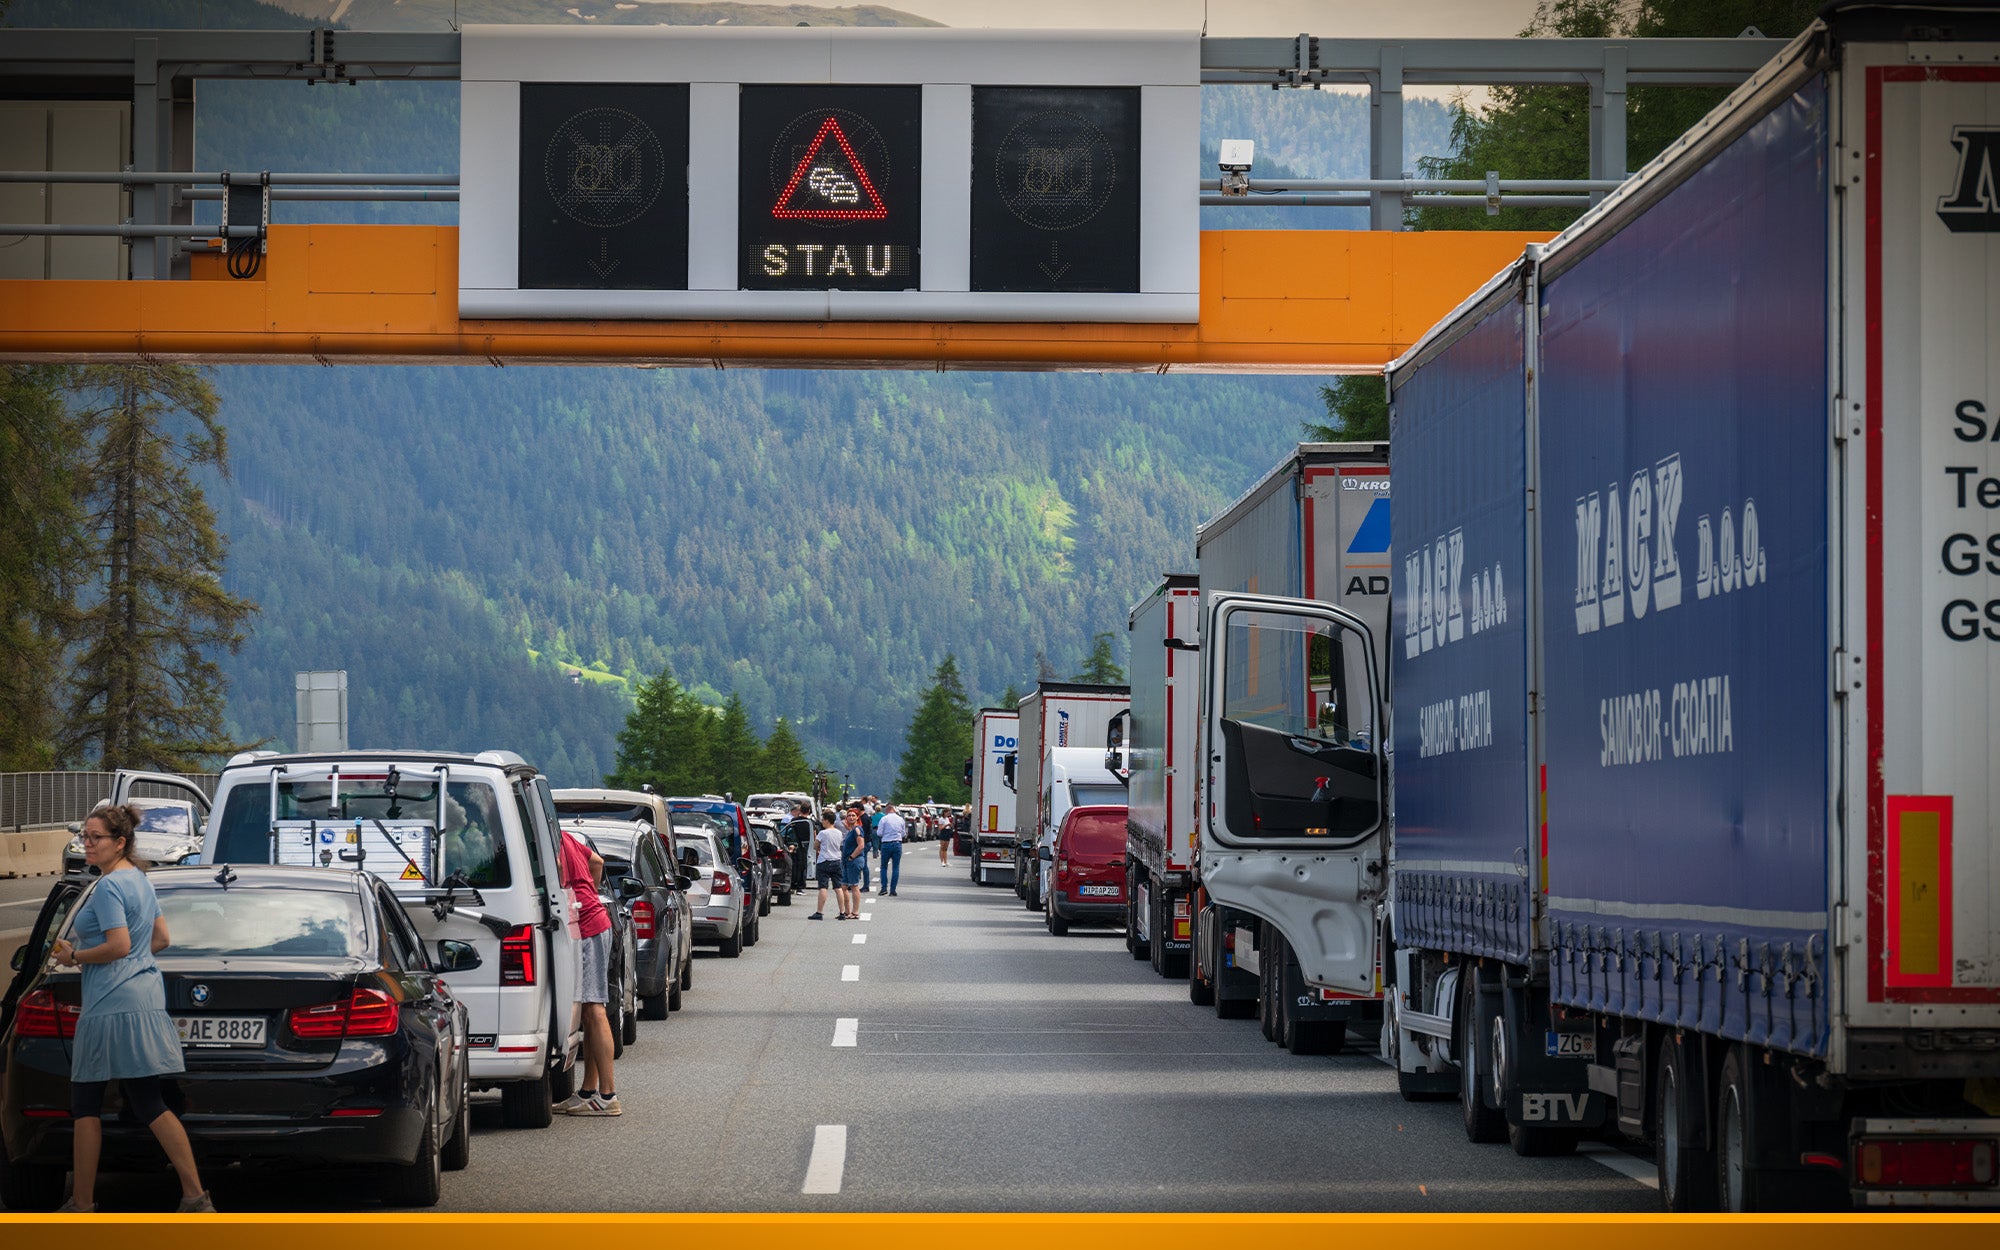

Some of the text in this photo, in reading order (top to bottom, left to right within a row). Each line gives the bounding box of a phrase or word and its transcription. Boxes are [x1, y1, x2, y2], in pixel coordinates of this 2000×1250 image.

[764, 244, 890, 276] STAU
[1954, 399, 2000, 443] S
[1575, 451, 1682, 636] MACK
[1345, 575, 1390, 596] AD
[1405, 526, 1464, 660] MACK
[1671, 674, 1733, 758] CROATIA
[189, 1020, 264, 1040] AE 8887
[1560, 1034, 1582, 1053] ZG
[1522, 1093, 1590, 1121] BTV
